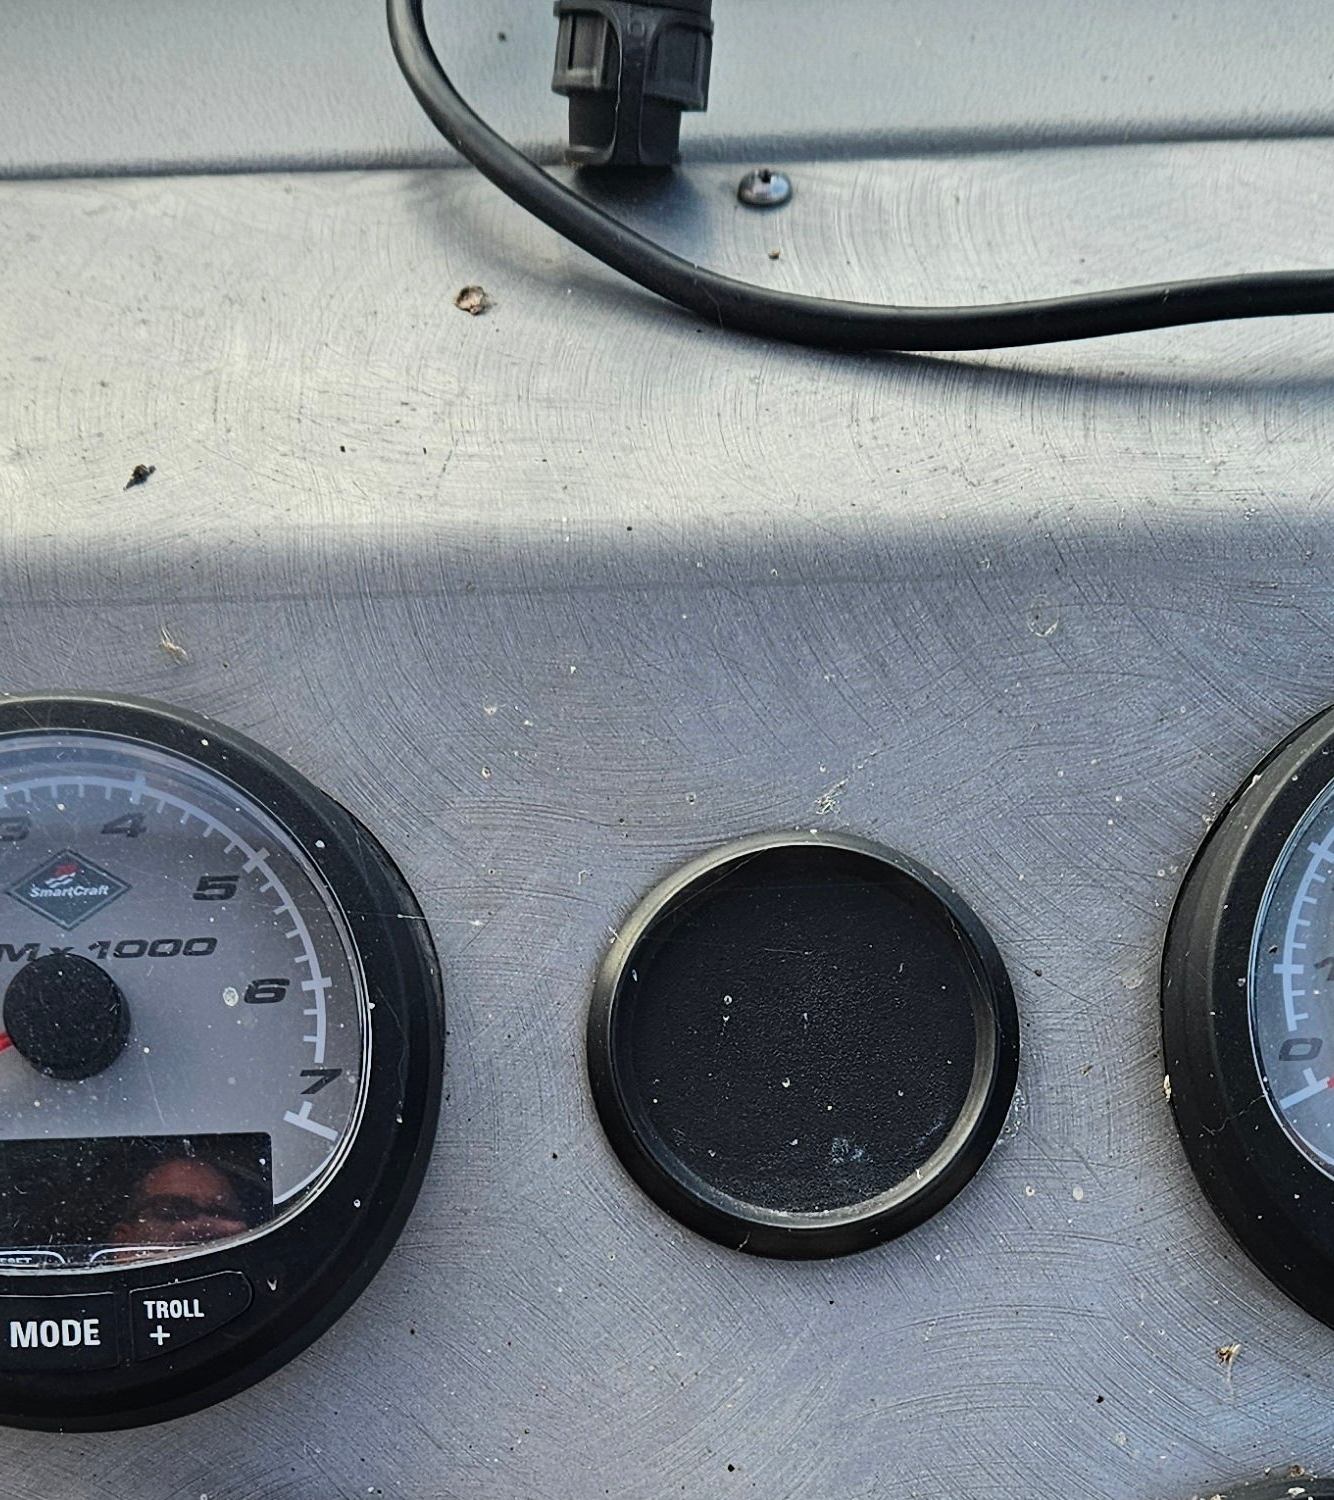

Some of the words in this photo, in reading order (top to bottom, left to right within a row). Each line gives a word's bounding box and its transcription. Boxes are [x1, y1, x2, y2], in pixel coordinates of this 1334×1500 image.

[100, 813, 147, 839] 4
[29, 883, 110, 899] SmartCraft
[192, 875, 240, 900] 5
[88, 937, 218, 962] 1000
[243, 978, 290, 1004] 6
[1279, 1038, 1323, 1062] 0
[300, 1068, 342, 1095] 7
[143, 1298, 205, 1321] TROLL
[9, 1319, 101, 1348] MODE
